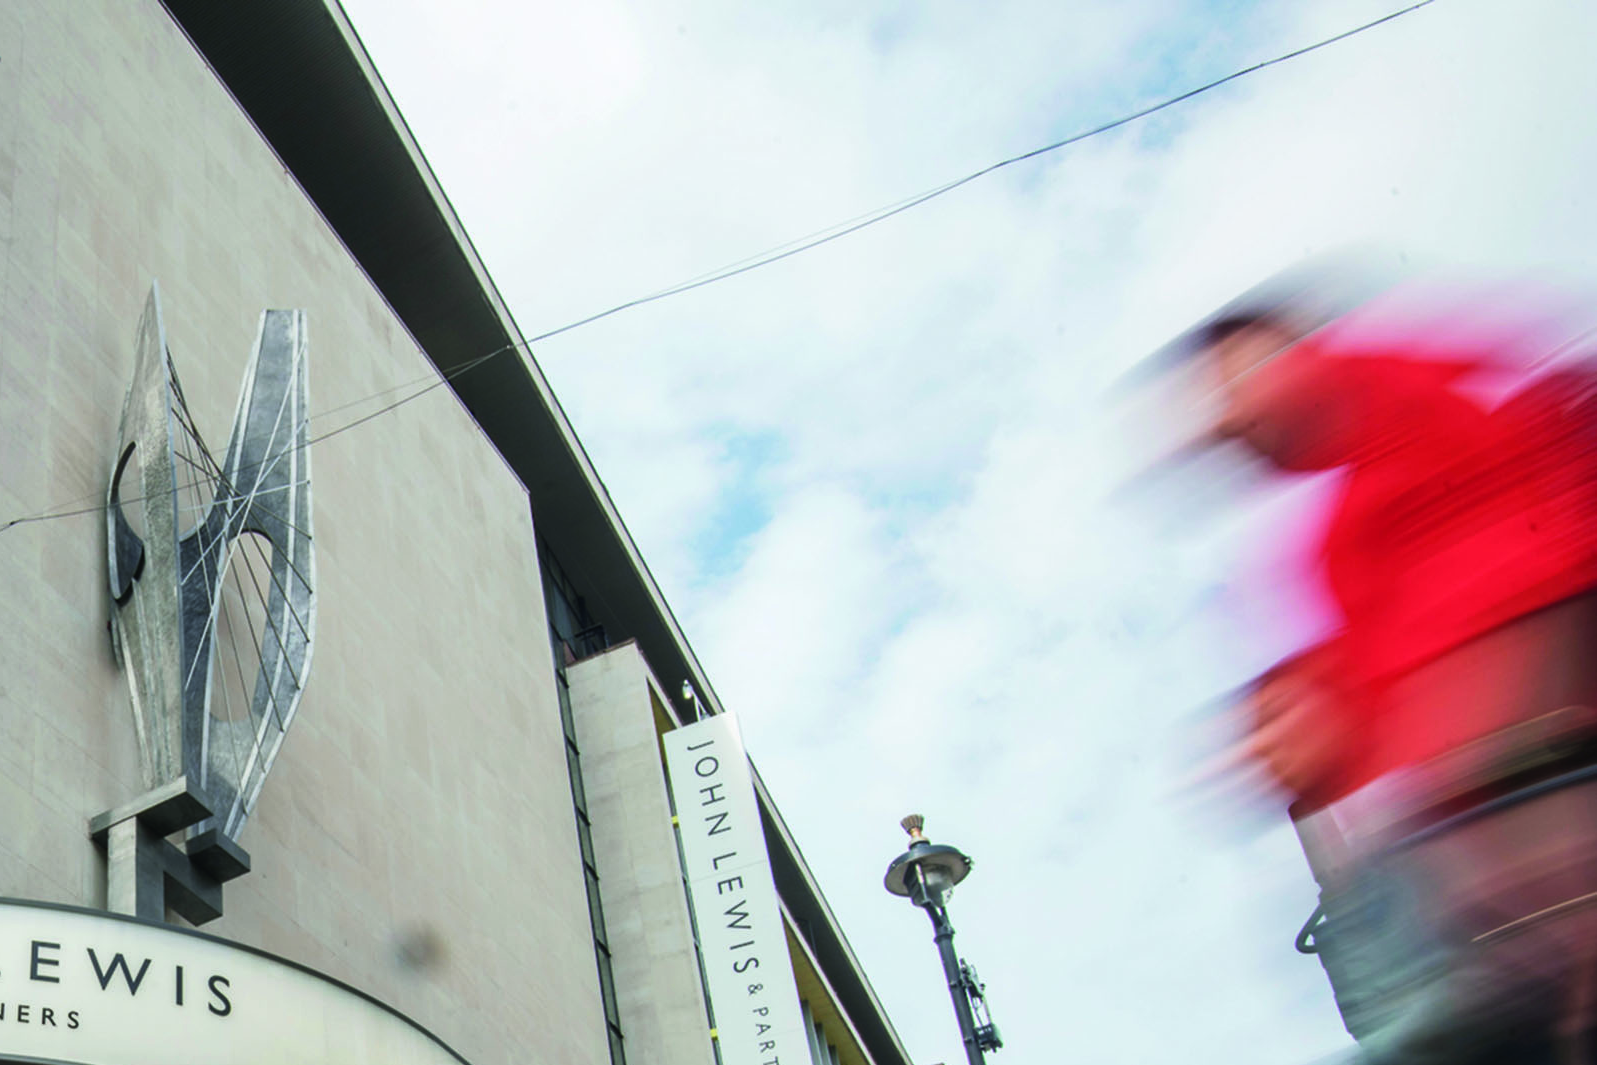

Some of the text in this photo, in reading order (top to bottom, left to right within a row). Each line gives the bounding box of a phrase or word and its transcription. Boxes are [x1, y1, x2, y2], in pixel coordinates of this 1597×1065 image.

[687, 740, 733, 837] JOHN
[712, 851, 760, 974] LEWIS
[747, 982, 764, 996] &
